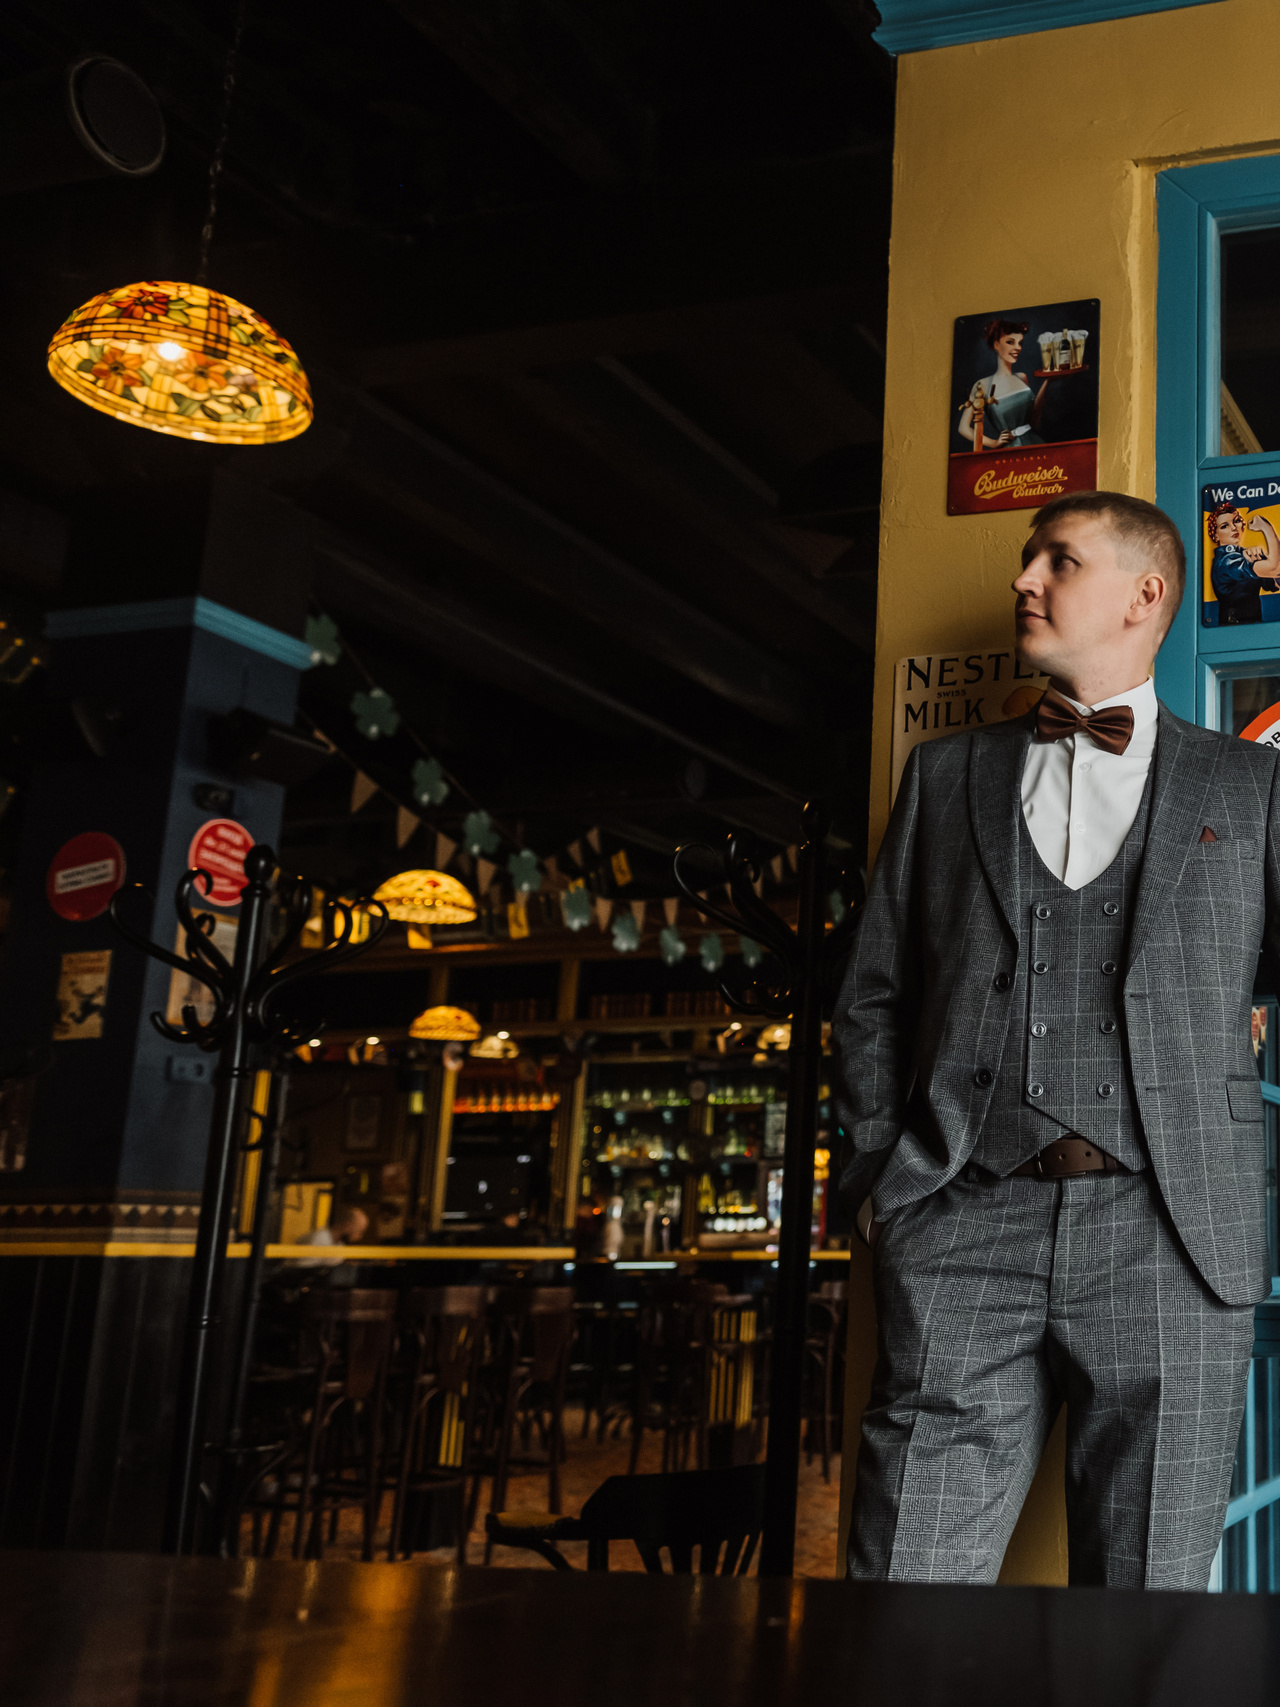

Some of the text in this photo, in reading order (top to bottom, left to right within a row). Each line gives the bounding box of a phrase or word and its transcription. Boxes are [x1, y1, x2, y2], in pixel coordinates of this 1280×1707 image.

[974, 465, 1068, 498] Budweiser
[1012, 483, 1064, 499] Budvar
[1211, 487, 1234, 503] We
[1237, 485, 1264, 499] Can
[907, 653, 1051, 690] NESTL
[936, 689, 967, 698] SWISS
[904, 698, 984, 733] MILK
